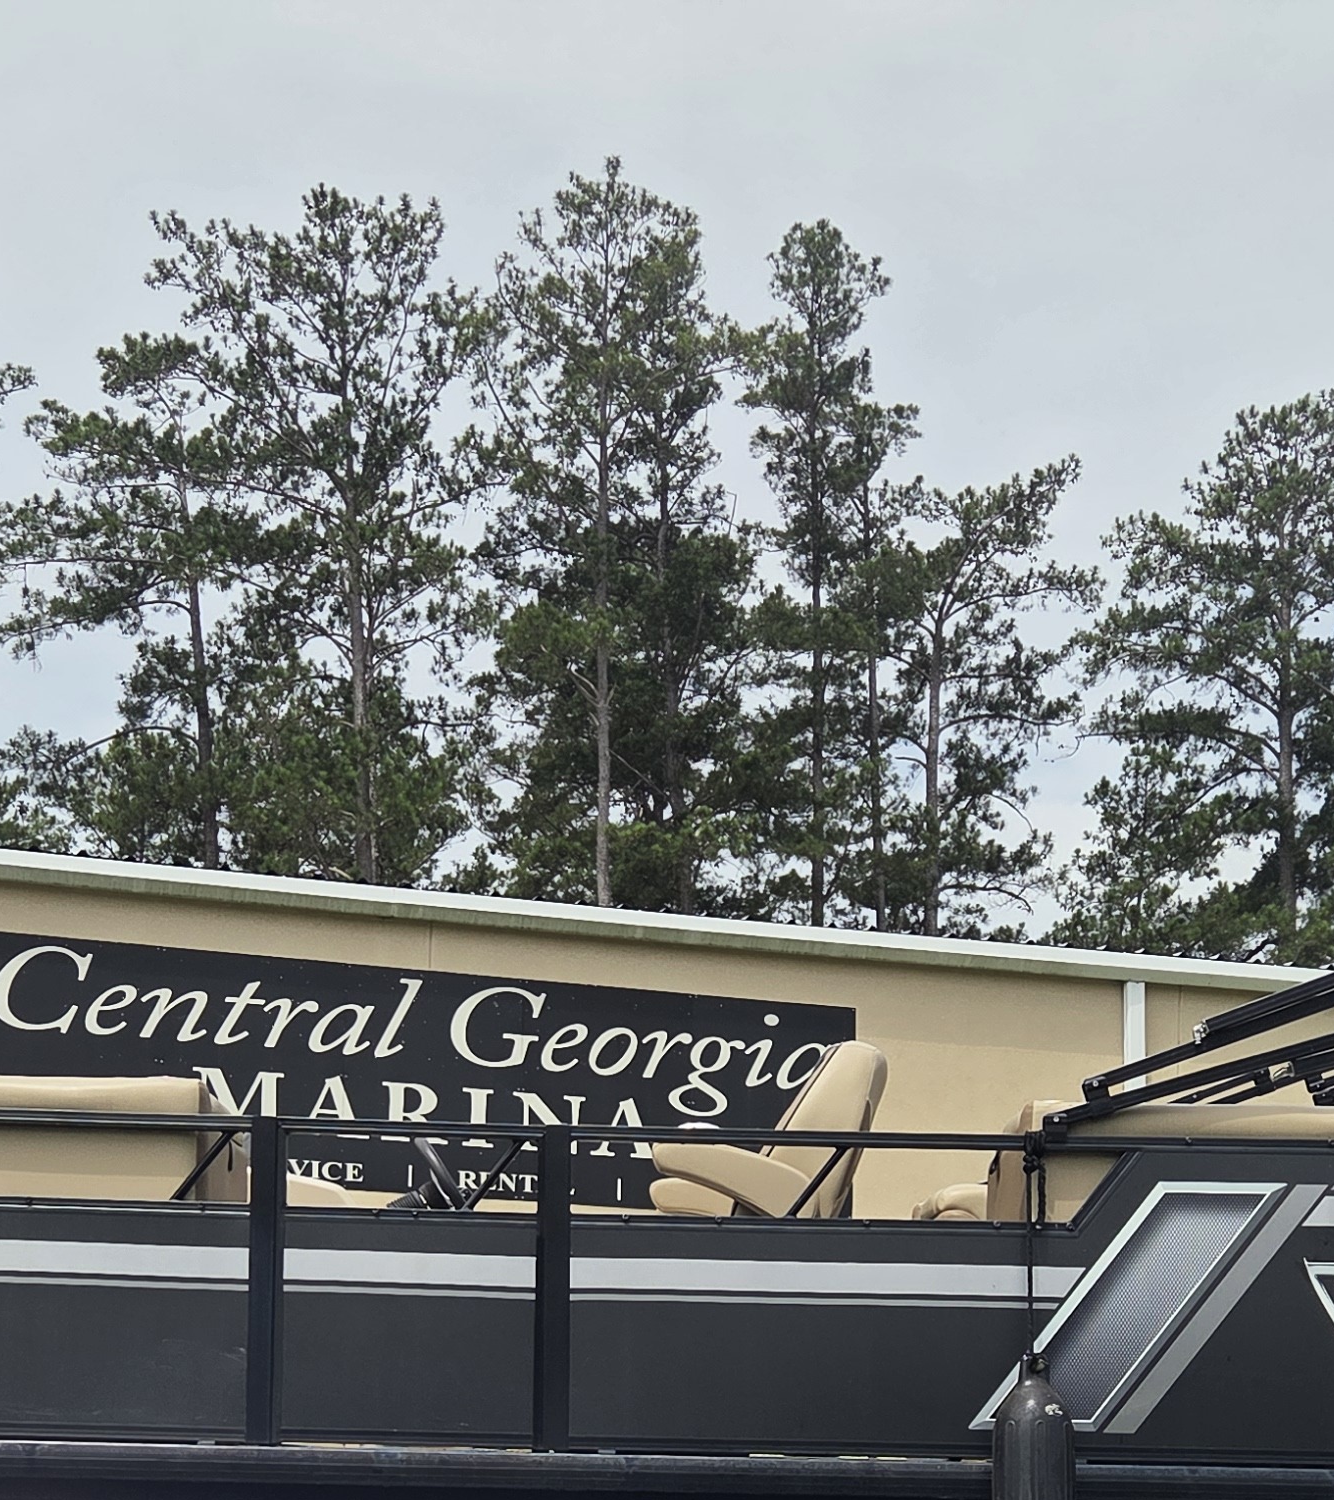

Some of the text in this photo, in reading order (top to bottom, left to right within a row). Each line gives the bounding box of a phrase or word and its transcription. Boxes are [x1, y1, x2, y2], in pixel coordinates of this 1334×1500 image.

[450, 986, 838, 1117] Georgia
[192, 1066, 654, 1159] MARINA
[286, 1158, 364, 1182] VICE
